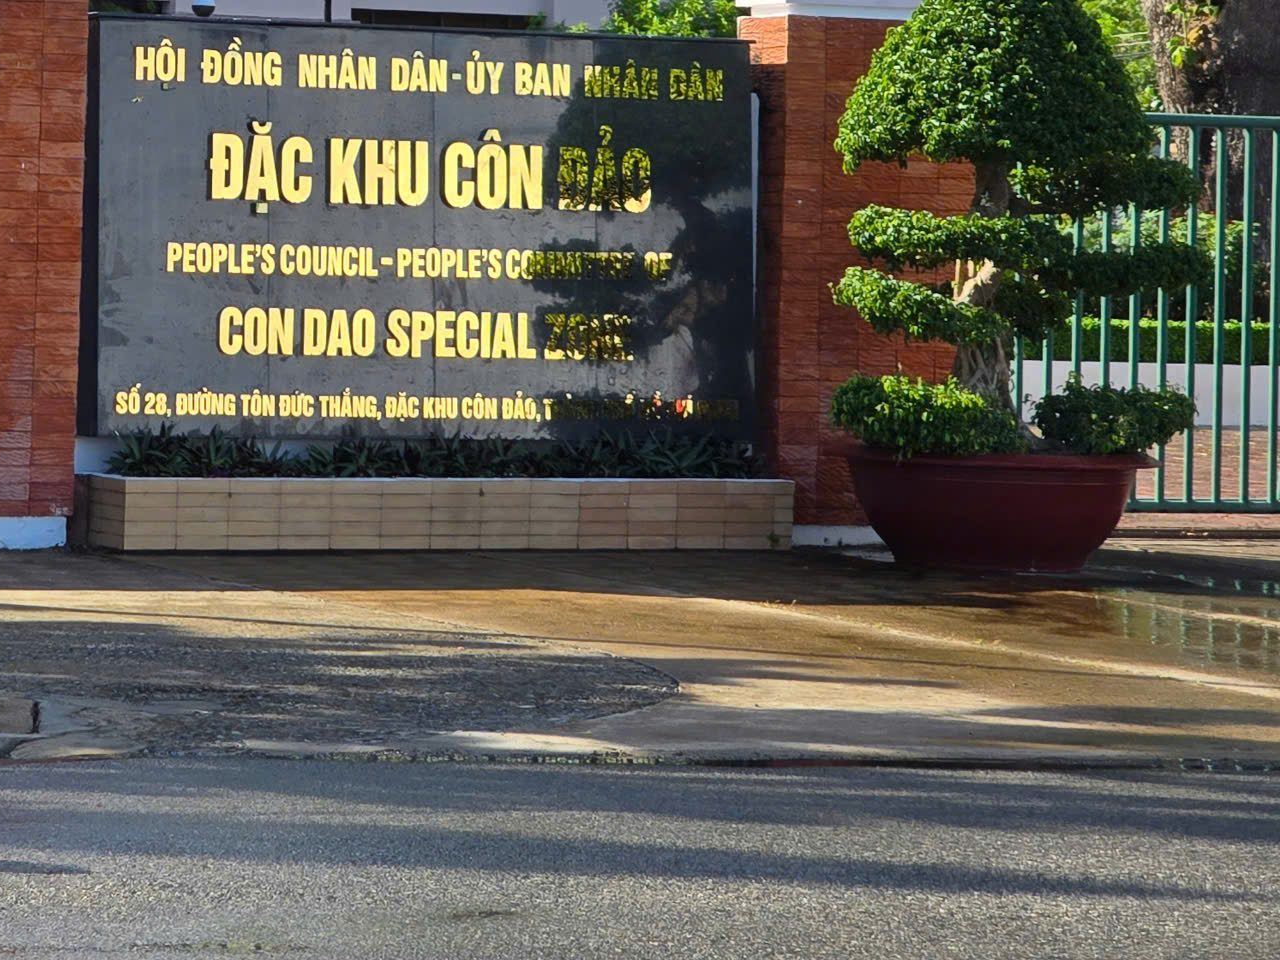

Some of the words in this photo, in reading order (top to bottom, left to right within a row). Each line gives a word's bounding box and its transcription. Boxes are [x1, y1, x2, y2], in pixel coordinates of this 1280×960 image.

[134, 38, 186, 90] HỘI
[201, 37, 282, 87] ĐỒNG
[298, 48, 377, 90] NHÂN
[514, 62, 571, 97] BAN
[583, 58, 658, 100] NHÂN
[669, 61, 724, 102] DÂN
[209, 120, 313, 214] ĐẶC
[329, 137, 430, 207] KHU
[444, 128, 544, 210] CÔN
[556, 124, 652, 214] ĐẢO
[166, 241, 276, 276] PEOPLE'S
[280, 245, 379, 278] COUNCIL
[396, 247, 502, 279] PEOPLE'S
[643, 251, 673, 281] OF
[219, 306, 295, 357] CON
[303, 308, 376, 357] DAO
[385, 309, 537, 360] SPECIAL
[544, 312, 635, 362] ZONE
[115, 382, 142, 416] SỐ
[144, 393, 172, 418] 28,
[175, 387, 236, 418] ĐƯỜNG
[240, 389, 277, 418] TÔN
[279, 390, 315, 419] ĐỨC
[319, 387, 382, 422] THẮNG,
[385, 391, 420, 423] ĐẶC
[422, 397, 458, 421] KHU
[461, 393, 498, 421] CÔN
[501, 390, 542, 423] ĐẢO,
